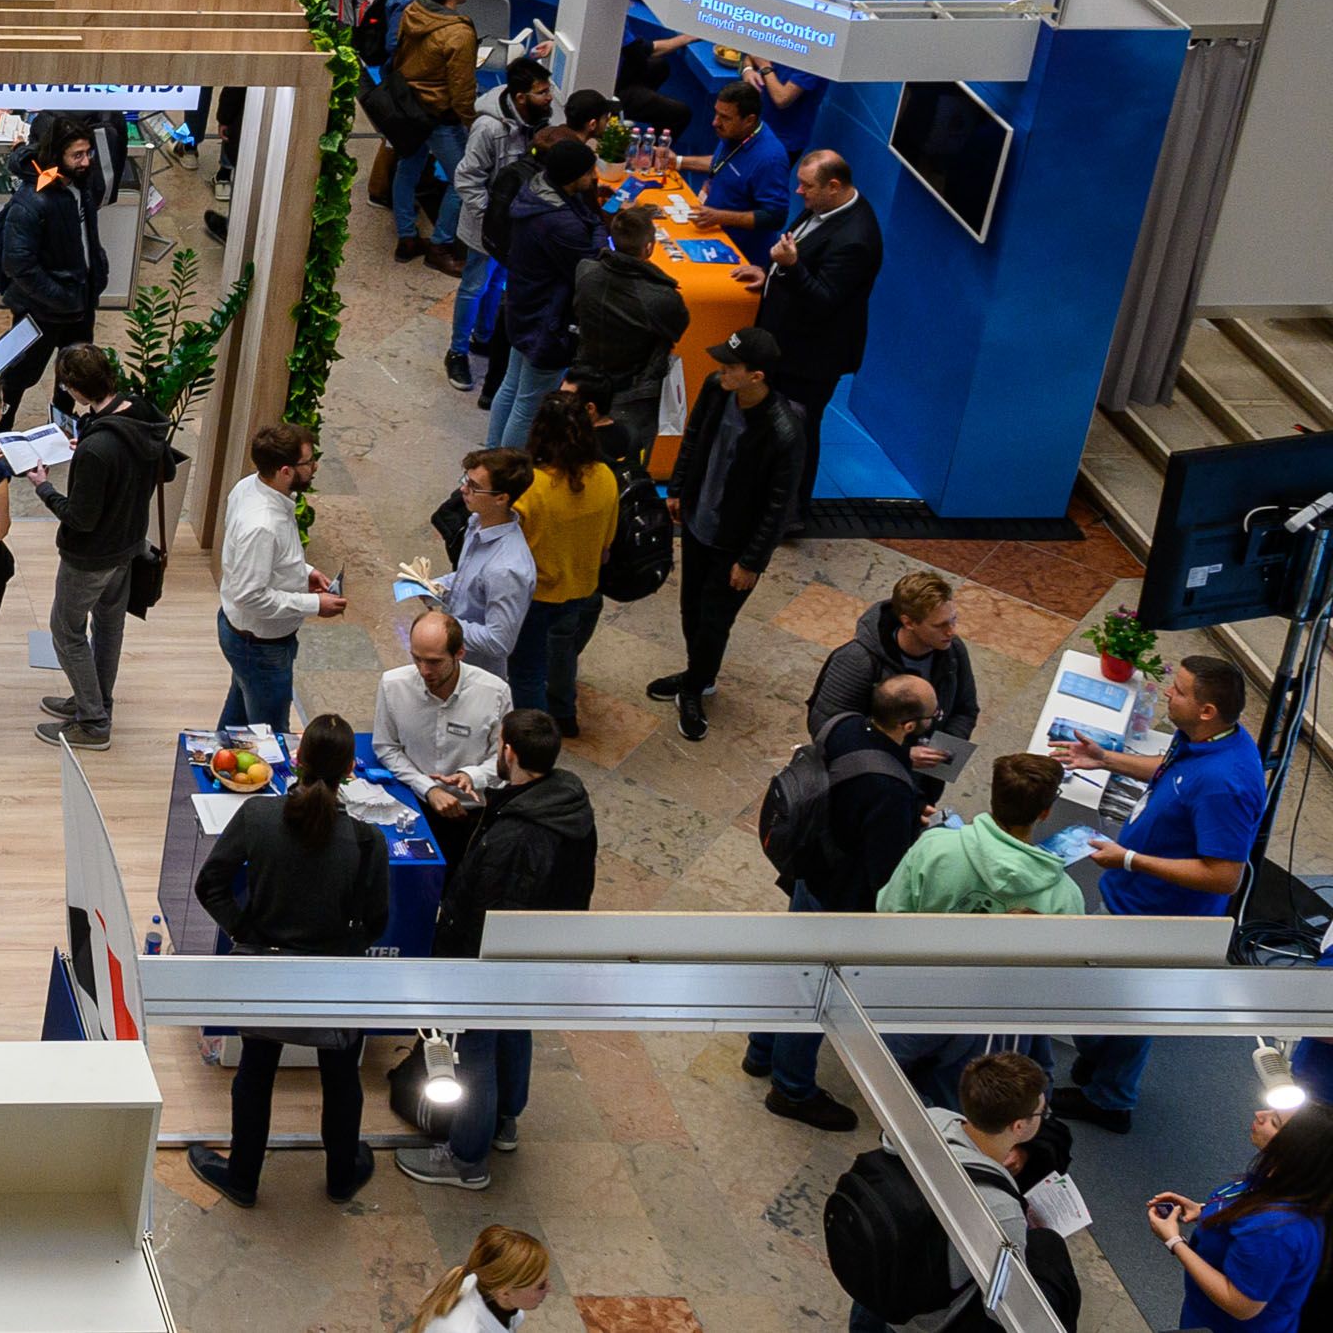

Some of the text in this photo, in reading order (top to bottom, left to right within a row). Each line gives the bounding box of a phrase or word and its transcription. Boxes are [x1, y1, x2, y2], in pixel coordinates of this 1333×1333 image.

[697, 10, 809, 54] Iránytű a repülésben
